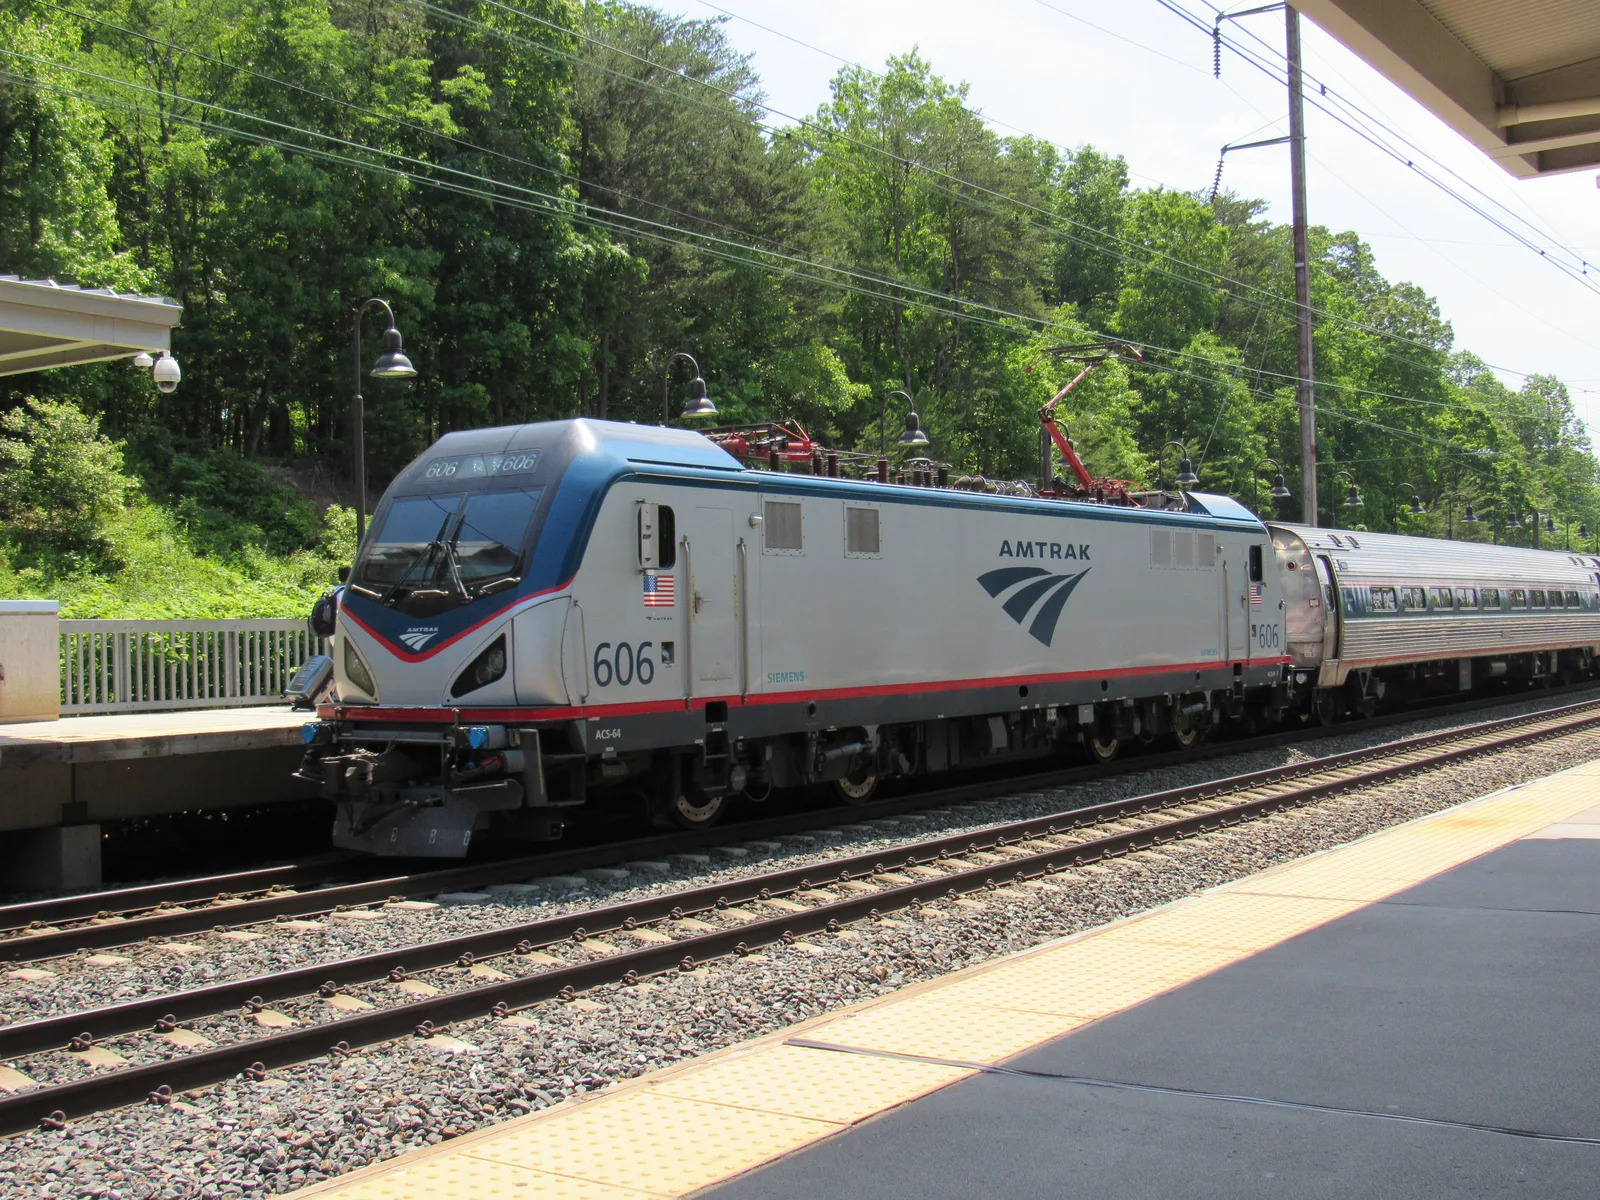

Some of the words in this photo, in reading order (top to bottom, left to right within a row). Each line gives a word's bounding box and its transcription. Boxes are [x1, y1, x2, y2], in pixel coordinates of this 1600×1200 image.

[426, 462, 458, 477] 606
[502, 454, 537, 471] 606
[999, 539, 1091, 561] AMTRAK
[1259, 623, 1279, 649] 606
[593, 641, 655, 688] 606
[767, 671, 804, 683] SIEMENS
[595, 728, 621, 740] ACS-64
